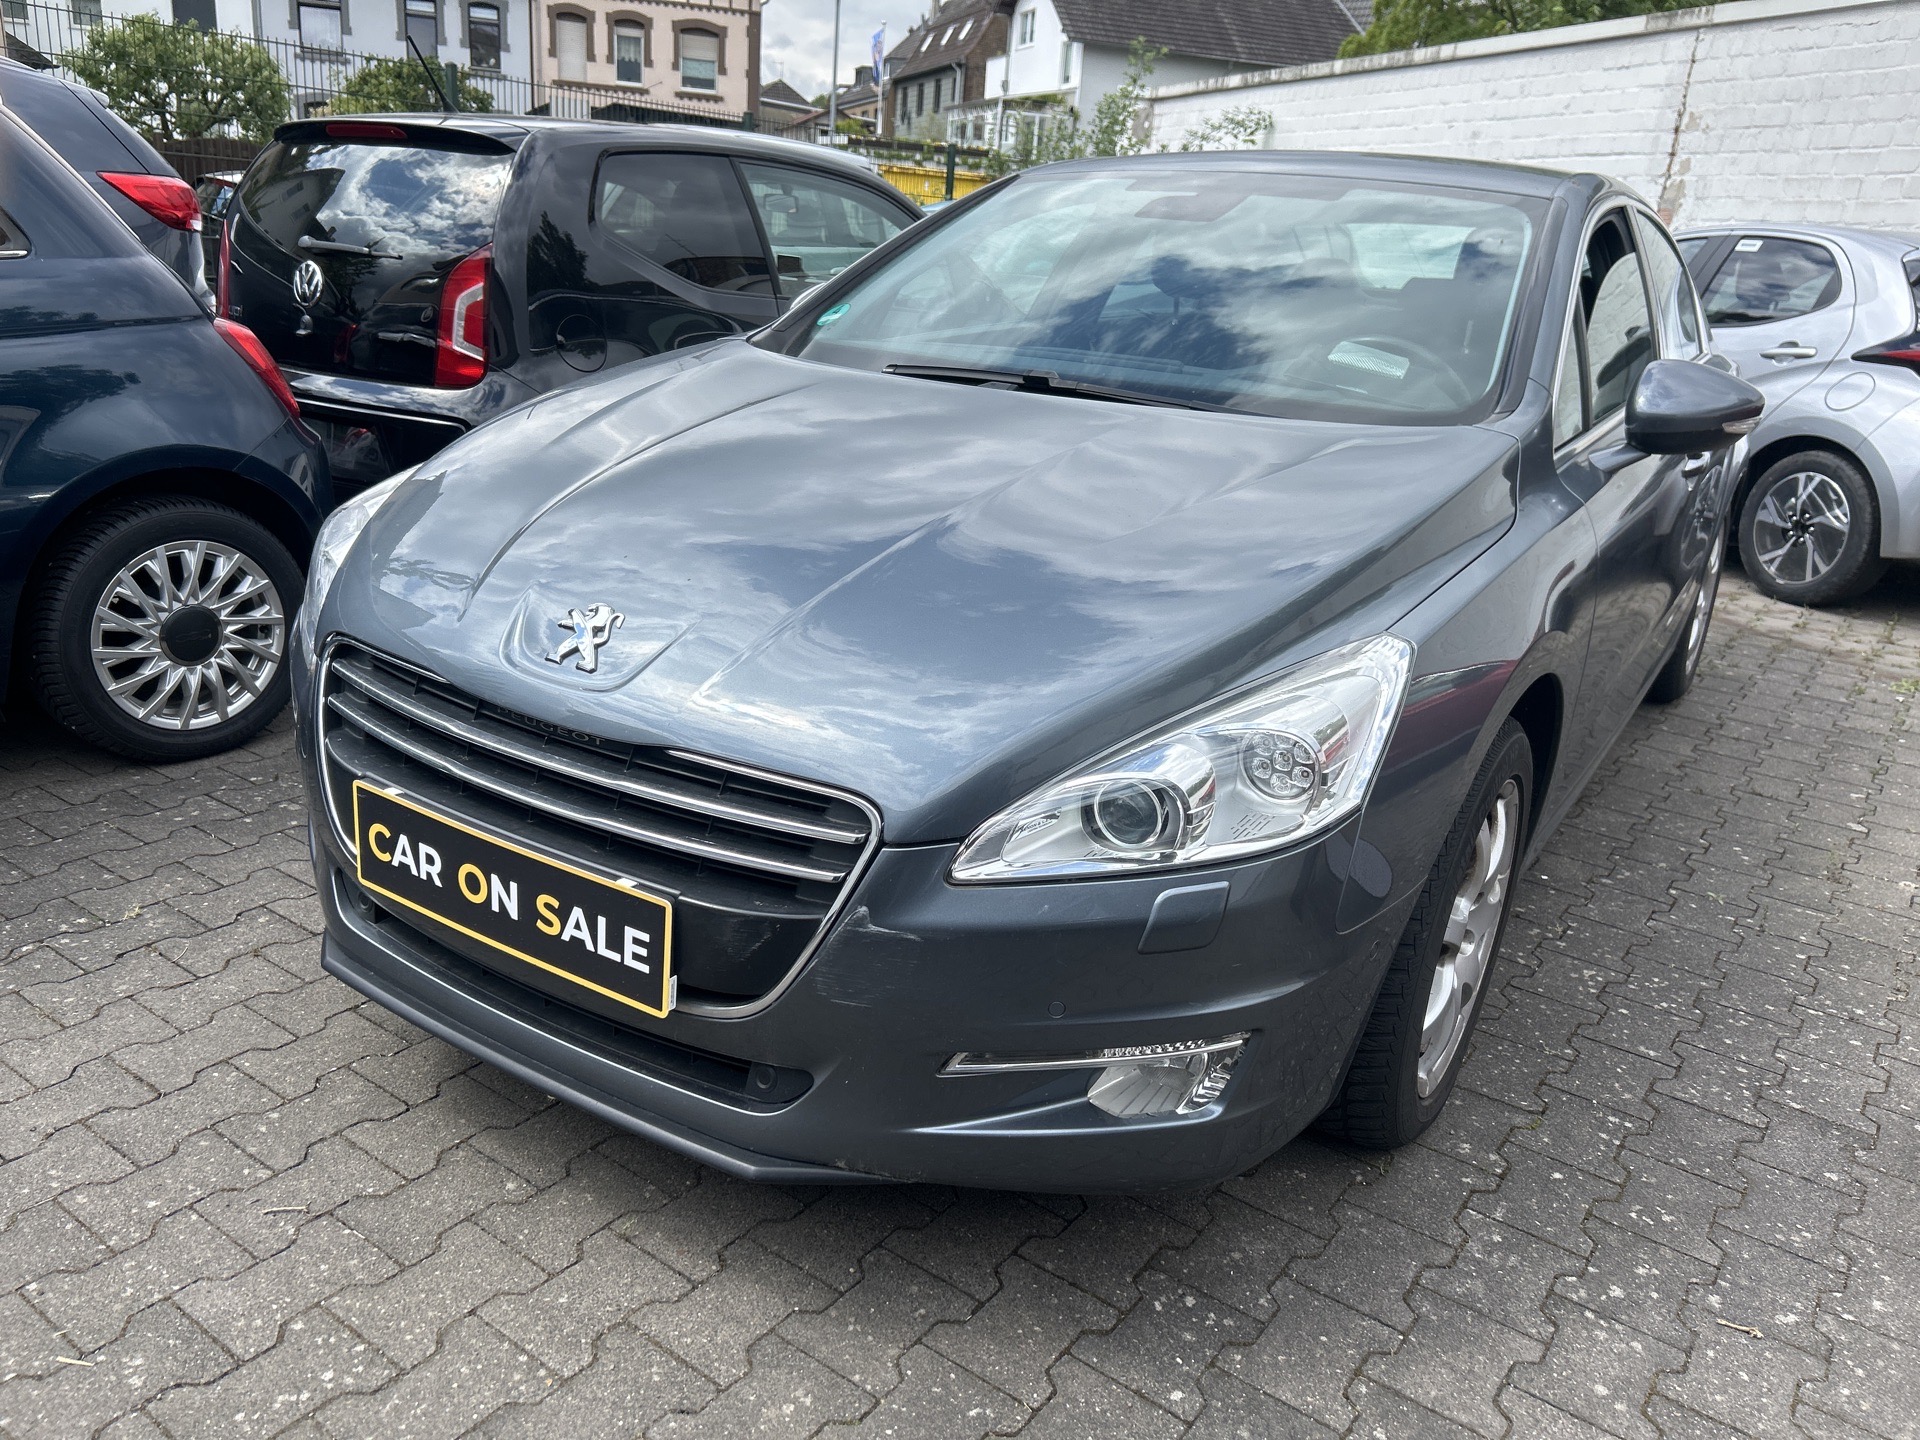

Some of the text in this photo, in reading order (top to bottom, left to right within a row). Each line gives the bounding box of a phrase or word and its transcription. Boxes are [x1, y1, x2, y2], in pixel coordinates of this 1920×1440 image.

[368, 823, 650, 974] CAR ON SALE
